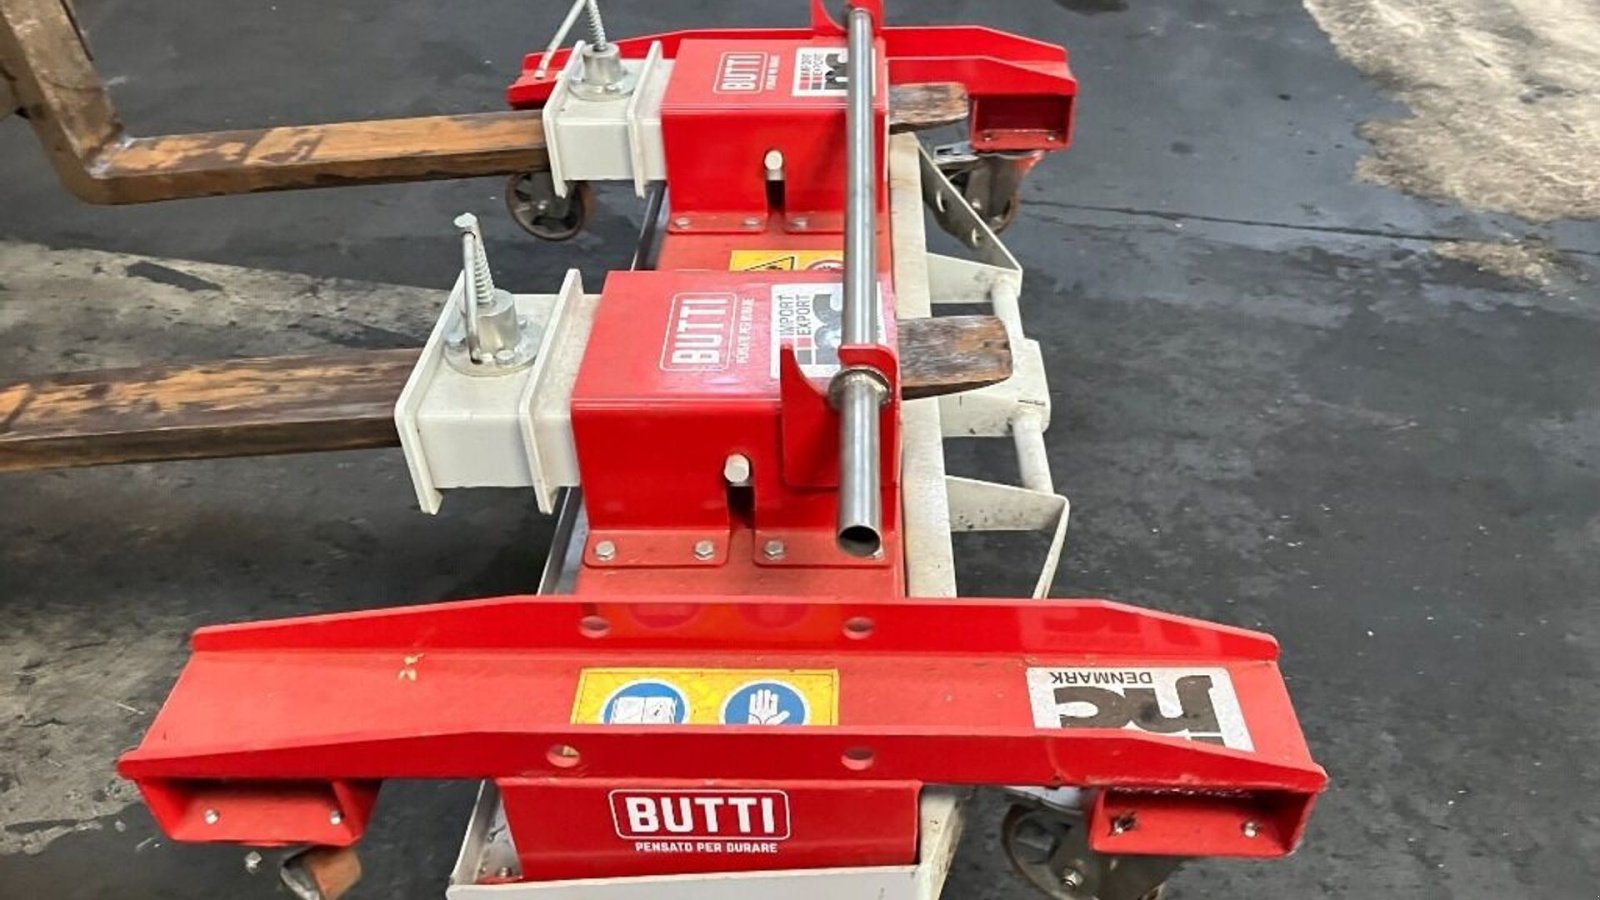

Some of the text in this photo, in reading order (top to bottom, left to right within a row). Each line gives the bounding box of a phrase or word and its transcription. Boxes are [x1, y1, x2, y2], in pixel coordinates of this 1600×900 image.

[721, 54, 762, 90] BUTTI
[671, 299, 729, 364] BUTTI
[779, 295, 795, 336] IMPORT
[796, 295, 812, 336] EXPORT
[1050, 671, 1153, 684] DENMARK
[625, 797, 775, 833] BUTTI
[635, 842, 778, 854] PENSATO PER DURARE
